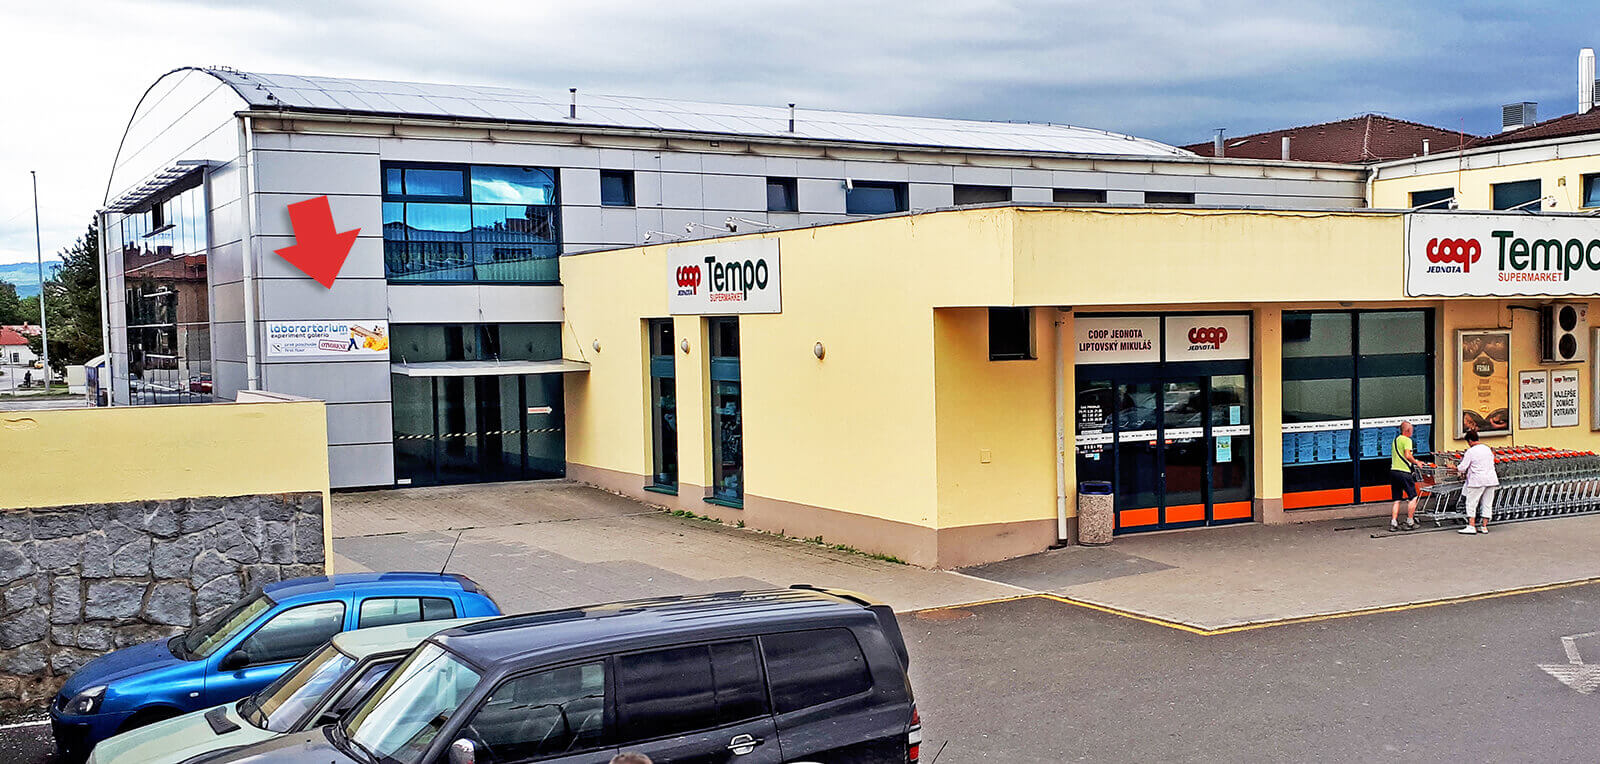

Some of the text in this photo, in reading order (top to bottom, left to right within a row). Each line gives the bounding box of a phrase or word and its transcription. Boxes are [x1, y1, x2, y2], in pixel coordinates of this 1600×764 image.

[1426, 238, 1482, 273] coop
[1491, 230, 1600, 281] Tempo
[1426, 265, 1461, 274] JEDNOTA
[704, 256, 768, 301] Tempo
[1498, 272, 1563, 282] SUPERMARKET
[709, 292, 743, 302] SUPERMARKET
[1088, 329, 1143, 339] COOP JEDNOTA
[1187, 327, 1228, 349] coop
[1079, 339, 1152, 352] LIPTOVSKÝ MIKULÁŠ
